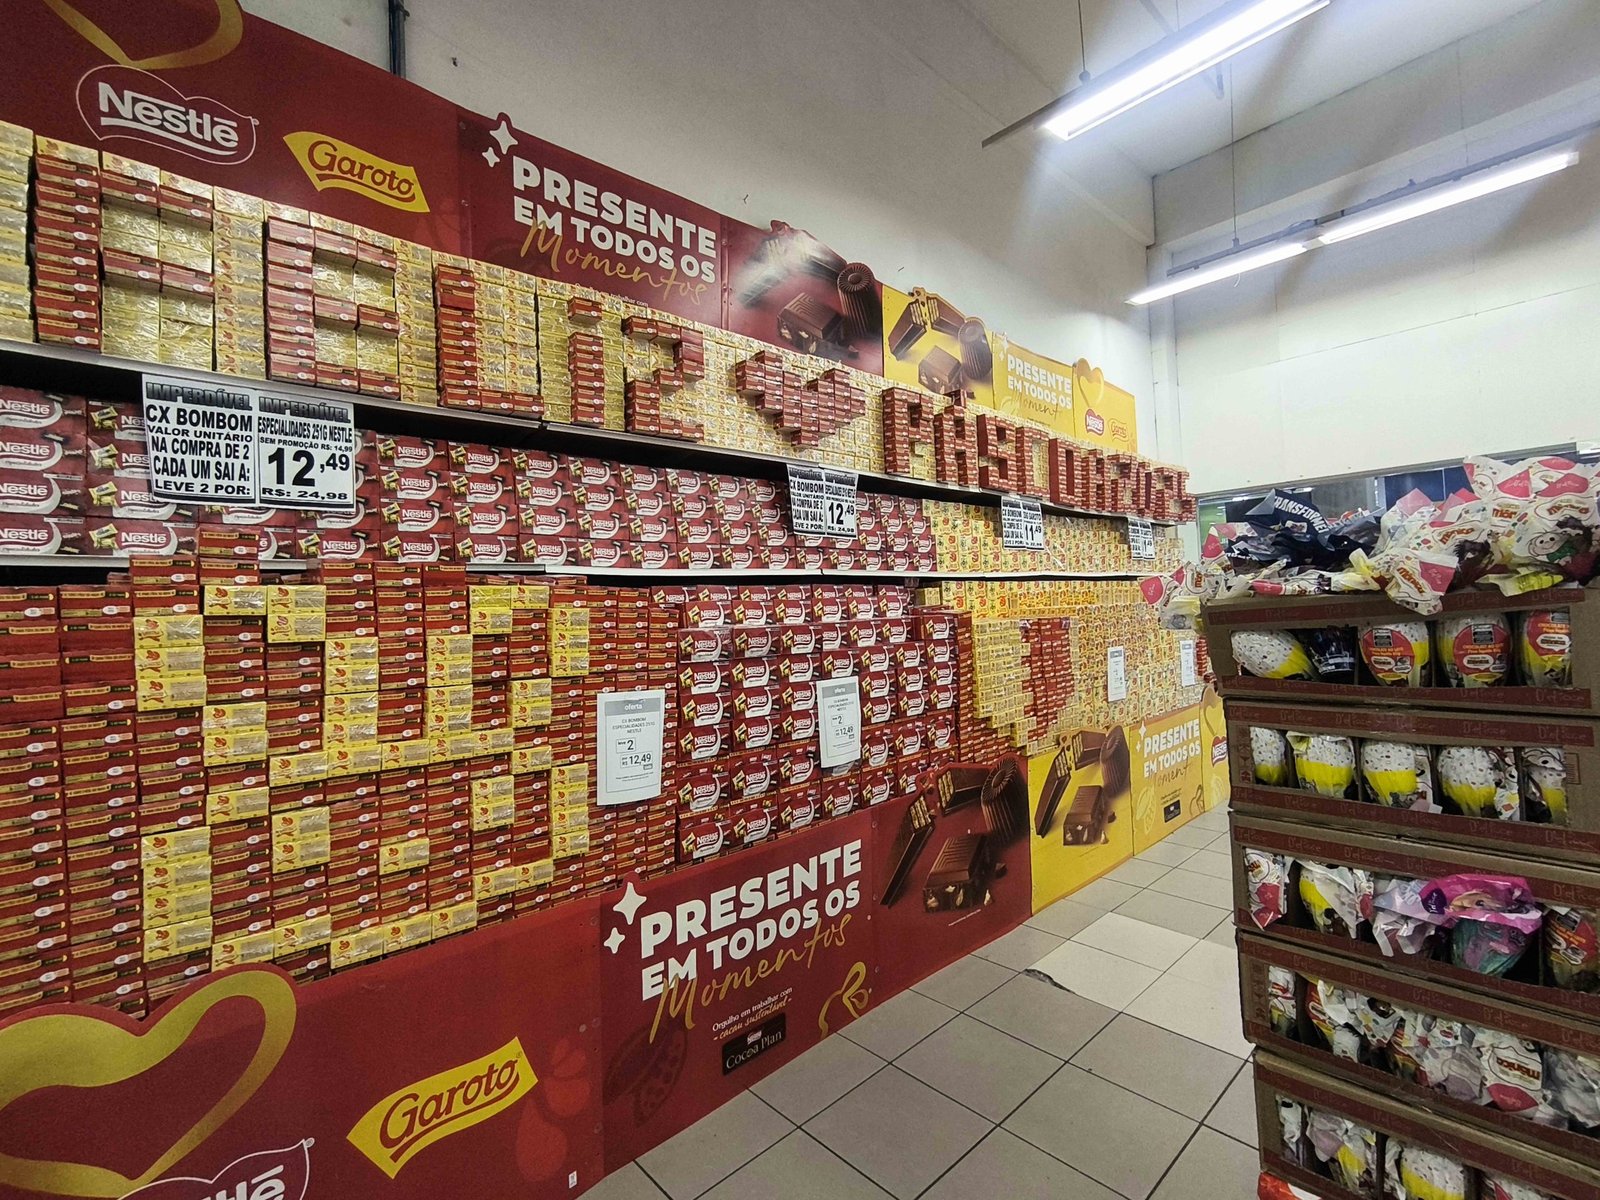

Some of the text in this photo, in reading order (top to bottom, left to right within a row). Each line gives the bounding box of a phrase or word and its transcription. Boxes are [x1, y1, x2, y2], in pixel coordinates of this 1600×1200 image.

[307, 140, 415, 196] Garoto
[513, 155, 717, 258] PRESENTE
[514, 195, 716, 283] EM TODOS OS
[520, 217, 707, 305] Momentos
[1007, 354, 1072, 394] PRESENTE
[146, 382, 252, 411] IMPERDÍVEL
[1008, 375, 1072, 409] EM TODOS OS
[146, 404, 252, 432] CX BOMBOM
[259, 396, 351, 424] IMPERDÍVEL
[147, 425, 252, 442] VALOR UNITÁRIO
[258, 416, 352, 443] ESPECIALIDADES 251G NESTLE
[260, 437, 276, 445] SEM
[278, 439, 319, 450] PROMOÇÃO
[151, 436, 249, 460] NA COMPRA DE 2
[153, 455, 250, 481] CADA UM SAI A:
[268, 447, 315, 487] 12
[155, 479, 250, 495] LEVE 2 POR:
[297, 491, 348, 500] 24,98
[797, 481, 824, 493] BOMBOM
[829, 502, 844, 525] 12
[1275, 496, 1329, 533] RANSFORME
[624, 703, 643, 711] oferta
[627, 739, 634, 750] 2
[1144, 718, 1200, 758] PRESENTE
[629, 753, 652, 766] 12,49
[1144, 740, 1200, 778] EM TODOS OS
[640, 839, 862, 959] PRESENTE
[642, 880, 860, 1001] EM TODOS OS
[649, 914, 852, 1043] Momentos
[712, 987, 792, 1031] Orgulho em trabalhar com
[726, 1031, 782, 1069] Cocoa Plan
[380, 1059, 518, 1149] Garoto
